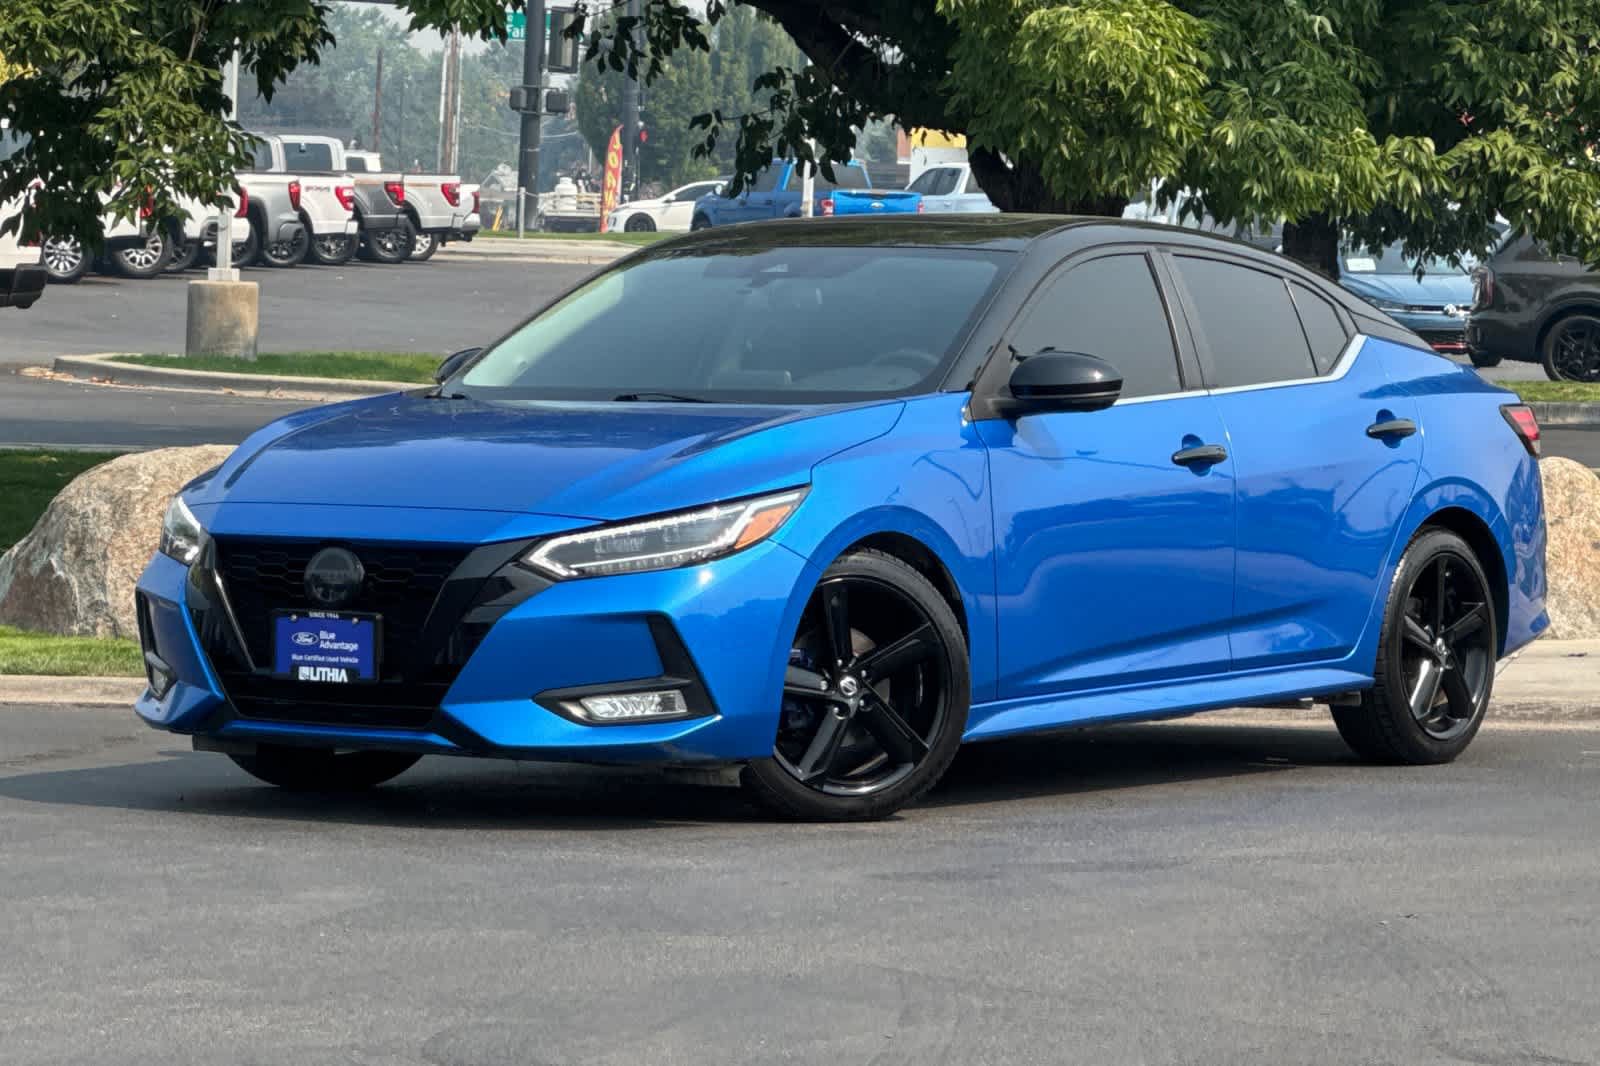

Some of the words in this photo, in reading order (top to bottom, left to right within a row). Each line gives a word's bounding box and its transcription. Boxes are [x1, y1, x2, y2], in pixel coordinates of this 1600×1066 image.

[295, 633, 314, 644] Ford
[320, 630, 336, 640] Blue
[320, 640, 358, 652] Advantage
[310, 666, 348, 682] LITHIA
